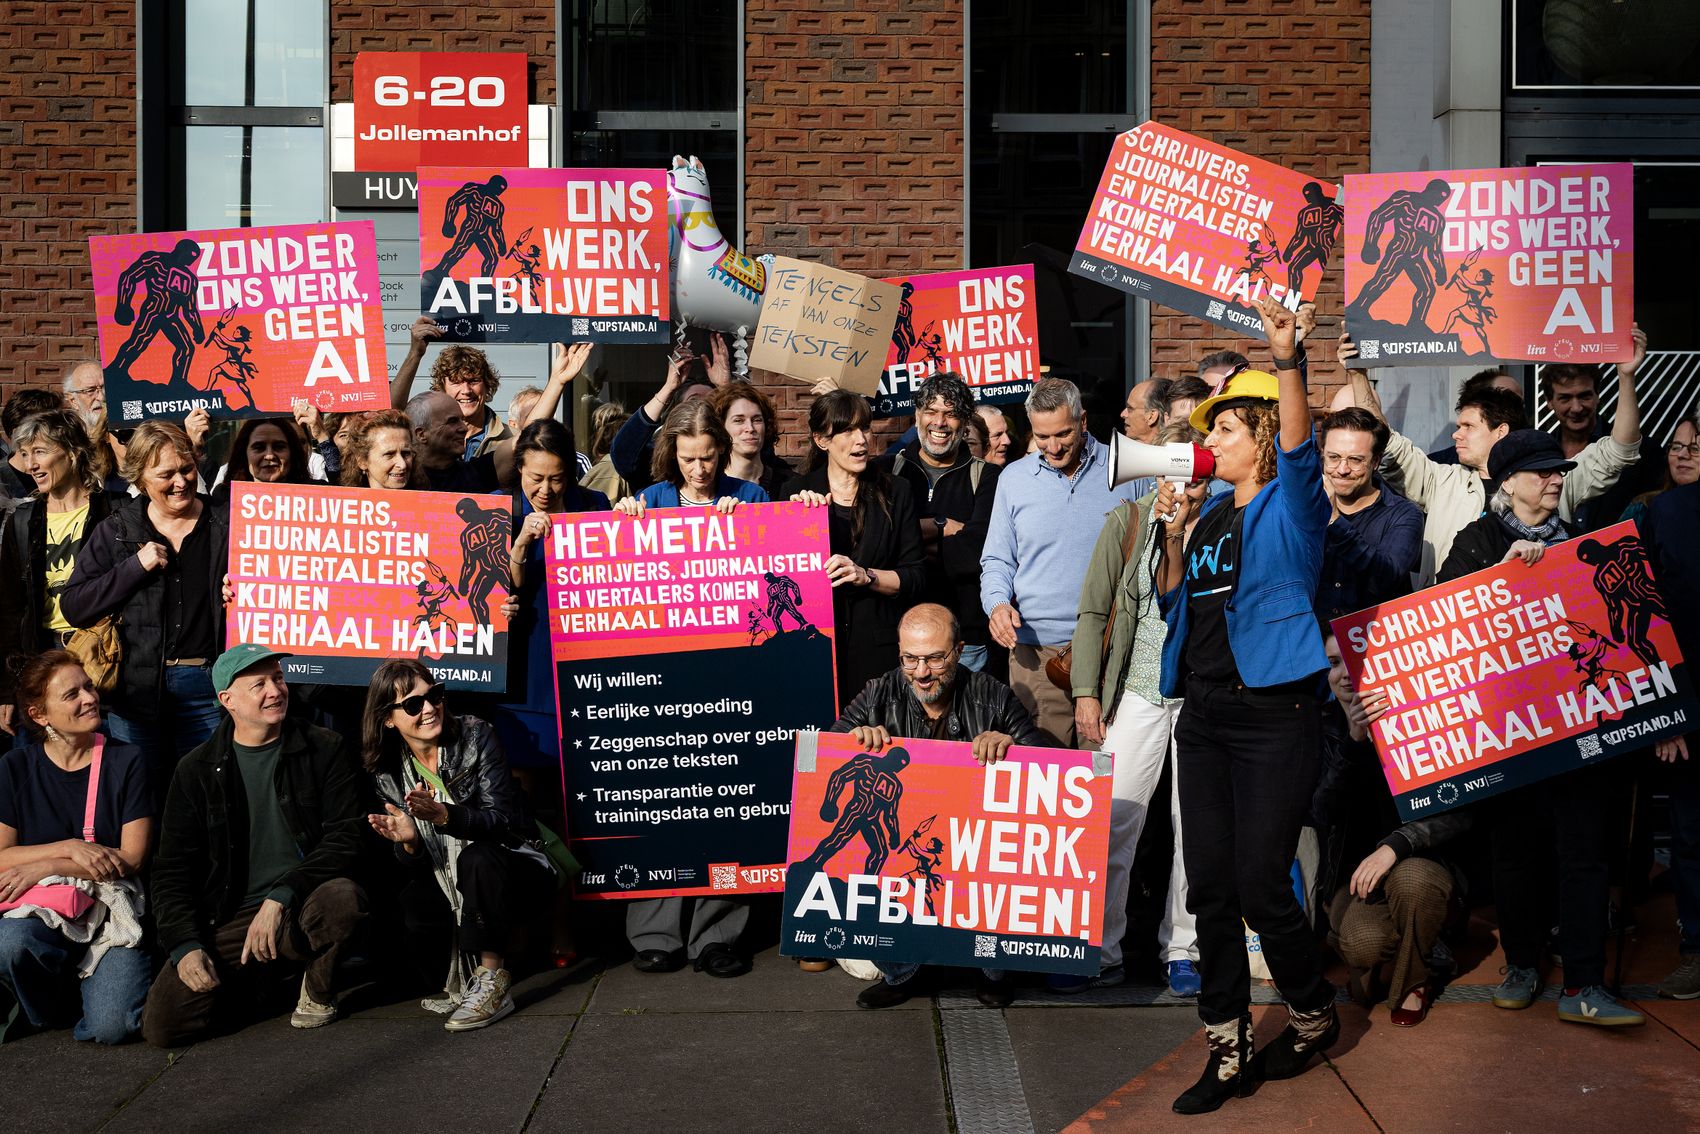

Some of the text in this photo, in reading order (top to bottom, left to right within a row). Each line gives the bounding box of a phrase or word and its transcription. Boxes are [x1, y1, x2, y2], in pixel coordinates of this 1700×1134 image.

[374, 76, 505, 106] 6-20
[360, 124, 521, 141] Jollemanhof
[1124, 127, 1250, 189] SCHRIJVERS,
[568, 180, 653, 223] ONS
[1115, 151, 1274, 221] JOURNALISTEN
[1445, 176, 1610, 218] ZONDER
[1098, 196, 1176, 241] KOMEN
[1108, 174, 1262, 243] EN VERTALERS
[544, 228, 660, 272] WERK,
[1090, 220, 1204, 286] VERHAAL
[1443, 215, 1620, 252] ONS WERK,
[196, 234, 356, 277] ZONDER
[1508, 248, 1612, 287] GEEN
[197, 271, 368, 311] ONS WERK,
[429, 277, 659, 316] AFBLIJVEN!
[958, 274, 1024, 313] ONS
[1542, 286, 1613, 335] AI
[264, 302, 365, 341] GEEN
[768, 296, 878, 337] AF VAN ONZE
[942, 312, 1032, 353] WERK,
[304, 338, 370, 387] AI
[762, 324, 869, 368] TEKSTEN
[241, 494, 398, 528] SCHRIJVERS,
[239, 525, 429, 558] JOURNALISTEN
[554, 521, 620, 560] HEY
[634, 515, 736, 556] META!
[239, 554, 426, 586] EN VERTALERS
[557, 552, 823, 586] SCHRIJVERS, JOURNALISTEN
[238, 583, 328, 611] KOMEN
[558, 580, 759, 609] EN VERTALERS KOMEN
[237, 612, 494, 655] VERHAAL HALEN
[560, 606, 740, 634] VERHAAL HALEN
[1347, 578, 1522, 654] SCHRIJVERS,
[1361, 593, 1568, 685] JOURNALISTEN
[574, 672, 662, 691] Wij willen:
[1409, 626, 1574, 702] VERTALERS
[586, 698, 753, 721] Eerlijke vergoeding
[1379, 690, 1483, 745] KOMEN
[1390, 660, 1677, 781] VERHAAL HALEN
[589, 724, 820, 752] Zeggenschap over gebr
[590, 752, 738, 772] van onze teksten
[593, 783, 756, 804] Transparantie over
[983, 761, 1094, 819] ONS
[1410, 796, 1431, 810] lira
[1464, 778, 1485, 792] NVJ
[595, 803, 709, 824] trainingsdata
[713, 806, 735, 817] en
[950, 817, 1096, 883] WERK,
[581, 872, 606, 884] lira
[648, 870, 672, 881] NVJ
[793, 872, 1090, 940] AFBLIJVEN!
[794, 930, 816, 943] lira
[853, 935, 875, 945] NVJ
